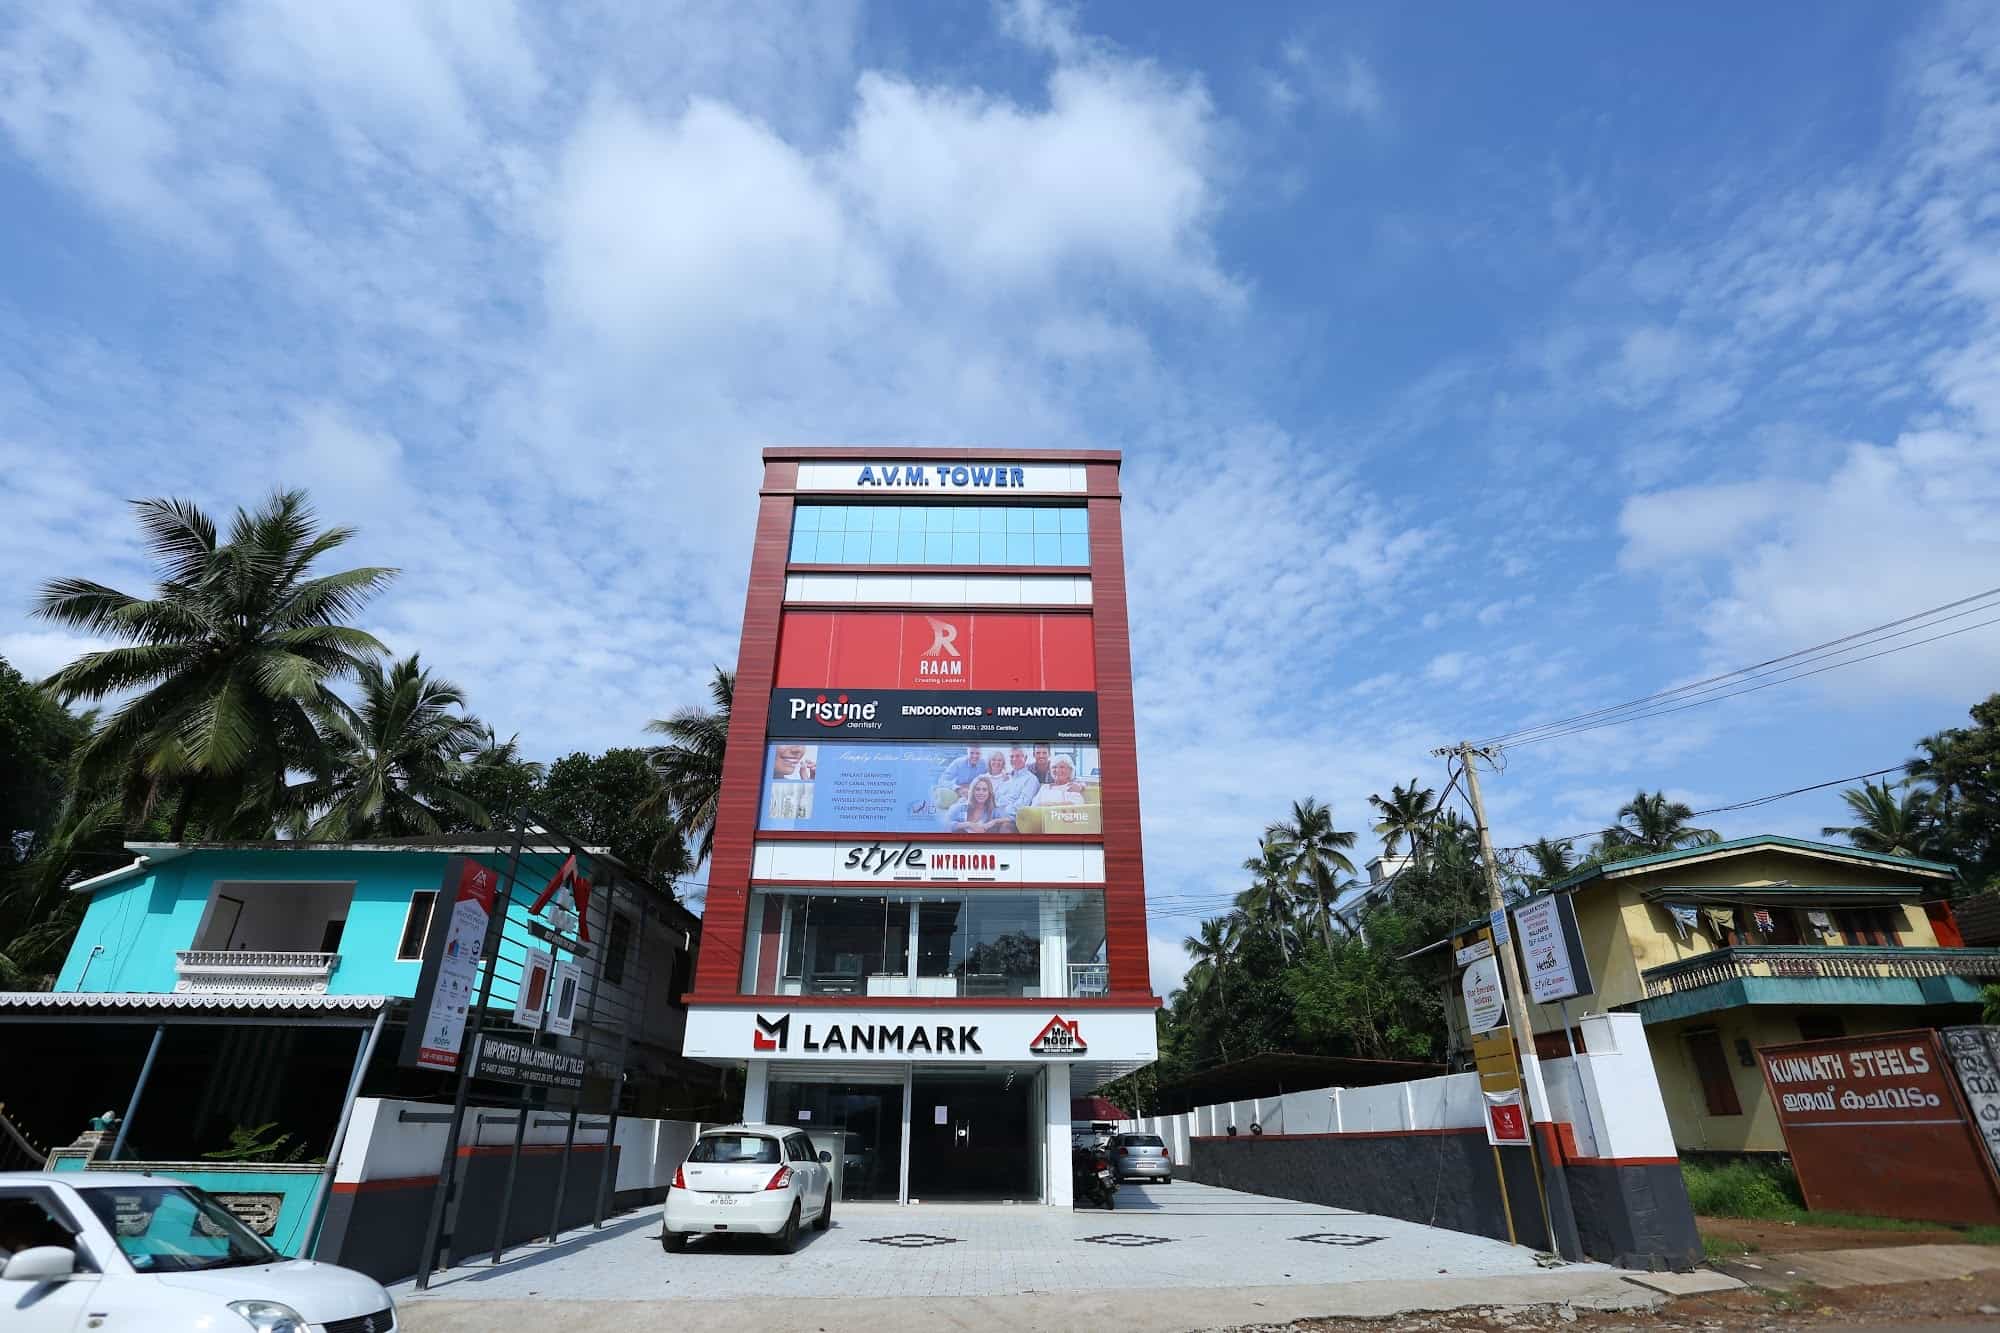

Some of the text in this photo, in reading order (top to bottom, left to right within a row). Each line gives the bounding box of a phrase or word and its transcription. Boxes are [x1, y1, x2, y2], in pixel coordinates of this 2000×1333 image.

[857, 466, 1024, 488] A.V.M. TOWER
[920, 660, 962, 675] RAAM
[789, 694, 877, 721] Pristine
[901, 705, 1084, 718] ENDODONTICS IMPLANTOLOGY
[846, 721, 882, 729] dentistry
[844, 842, 996, 875] style INTERIORS
[803, 1024, 983, 1053] LANMARK
[1043, 1036, 1074, 1046] ROOF
[483, 1040, 585, 1074] IMPORTED MALAYSIAN CLAY TILES
[1769, 1047, 1931, 1083] KUNNATH STEELS
